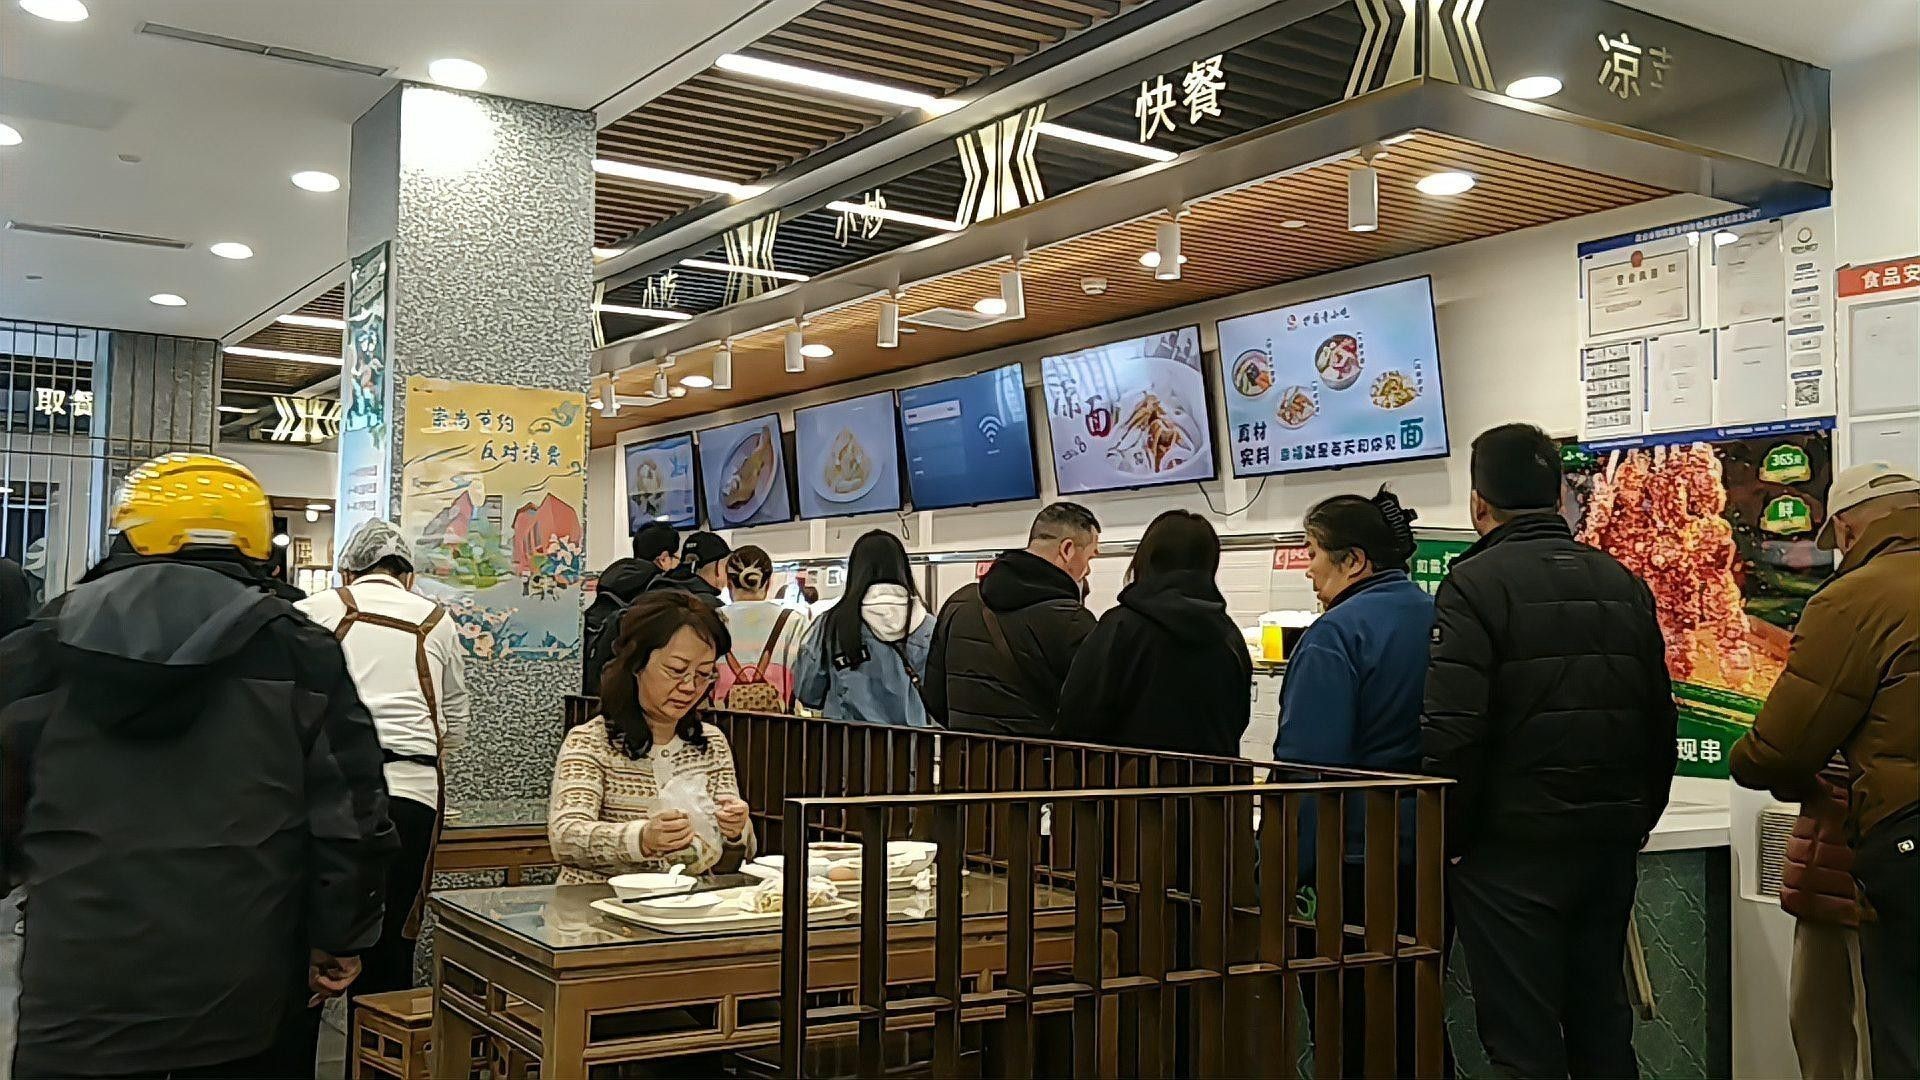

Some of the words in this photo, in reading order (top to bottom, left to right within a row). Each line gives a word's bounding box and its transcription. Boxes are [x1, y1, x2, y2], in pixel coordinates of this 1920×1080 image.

[1134, 54, 1226, 143] 快餐
[642, 268, 679, 309] 小吃
[1860, 263, 1920, 290] 食品安
[34, 387, 94, 417] 取餐
[432, 406, 515, 433] 崇尚节约
[1238, 420, 1267, 443] 真材
[480, 439, 562, 466] 反对浪费
[1676, 738, 1722, 764] 现串
